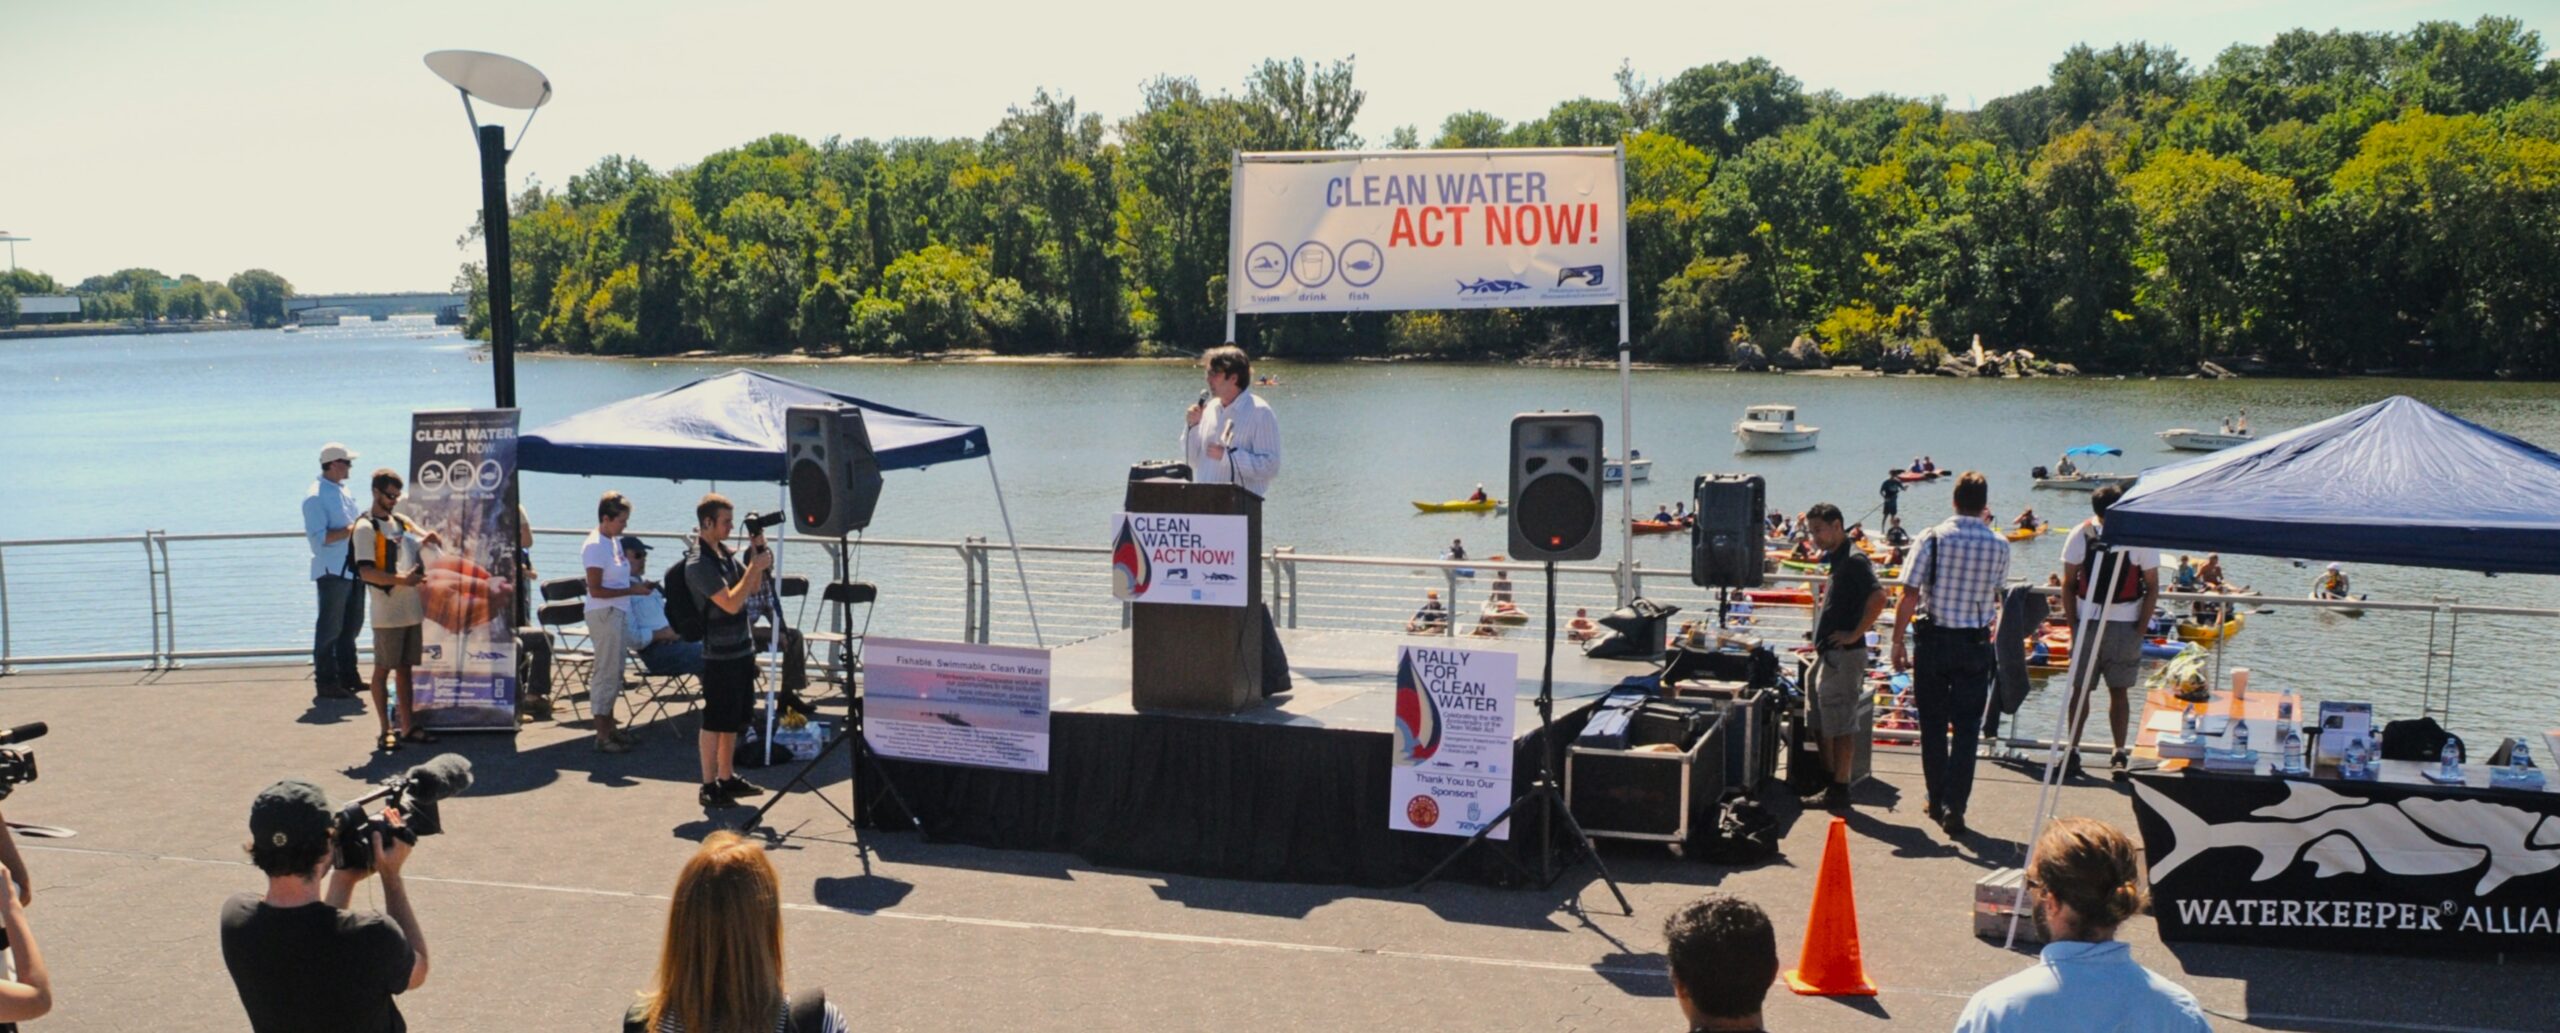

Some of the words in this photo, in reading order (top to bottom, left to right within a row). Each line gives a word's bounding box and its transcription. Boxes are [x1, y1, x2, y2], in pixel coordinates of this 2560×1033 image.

[1327, 175, 1427, 207] CLEAN
[1436, 171, 1546, 204] WATER
[1388, 206, 1470, 248] ACT
[1485, 203, 1599, 246] NOW!
[1298, 292, 1327, 302] drink
[1348, 291, 1370, 301] fish
[415, 429, 463, 442] CLEAN
[465, 427, 517, 440] WATER.
[435, 443, 464, 455] ACT
[1134, 516, 1190, 532] CLEAN
[1142, 533, 1206, 549] WATER.
[1153, 548, 1187, 564] ACT
[1191, 550, 1234, 565] NOW!
[1416, 649, 1470, 666] RALLY
[990, 663, 1015, 673] Clean
[1018, 666, 1043, 676] Water
[1424, 664, 1457, 680] FOR
[1430, 679, 1485, 695] CLEAN
[1439, 694, 1497, 711] WATER
[1416, 773, 1443, 785] Thank
[1446, 776, 1464, 786] You
[1466, 778, 1475, 787] to
[1477, 779, 1495, 788] Our
[1431, 786, 1478, 799] Sponsors!
[2458, 905, 2560, 934] ALLIA
